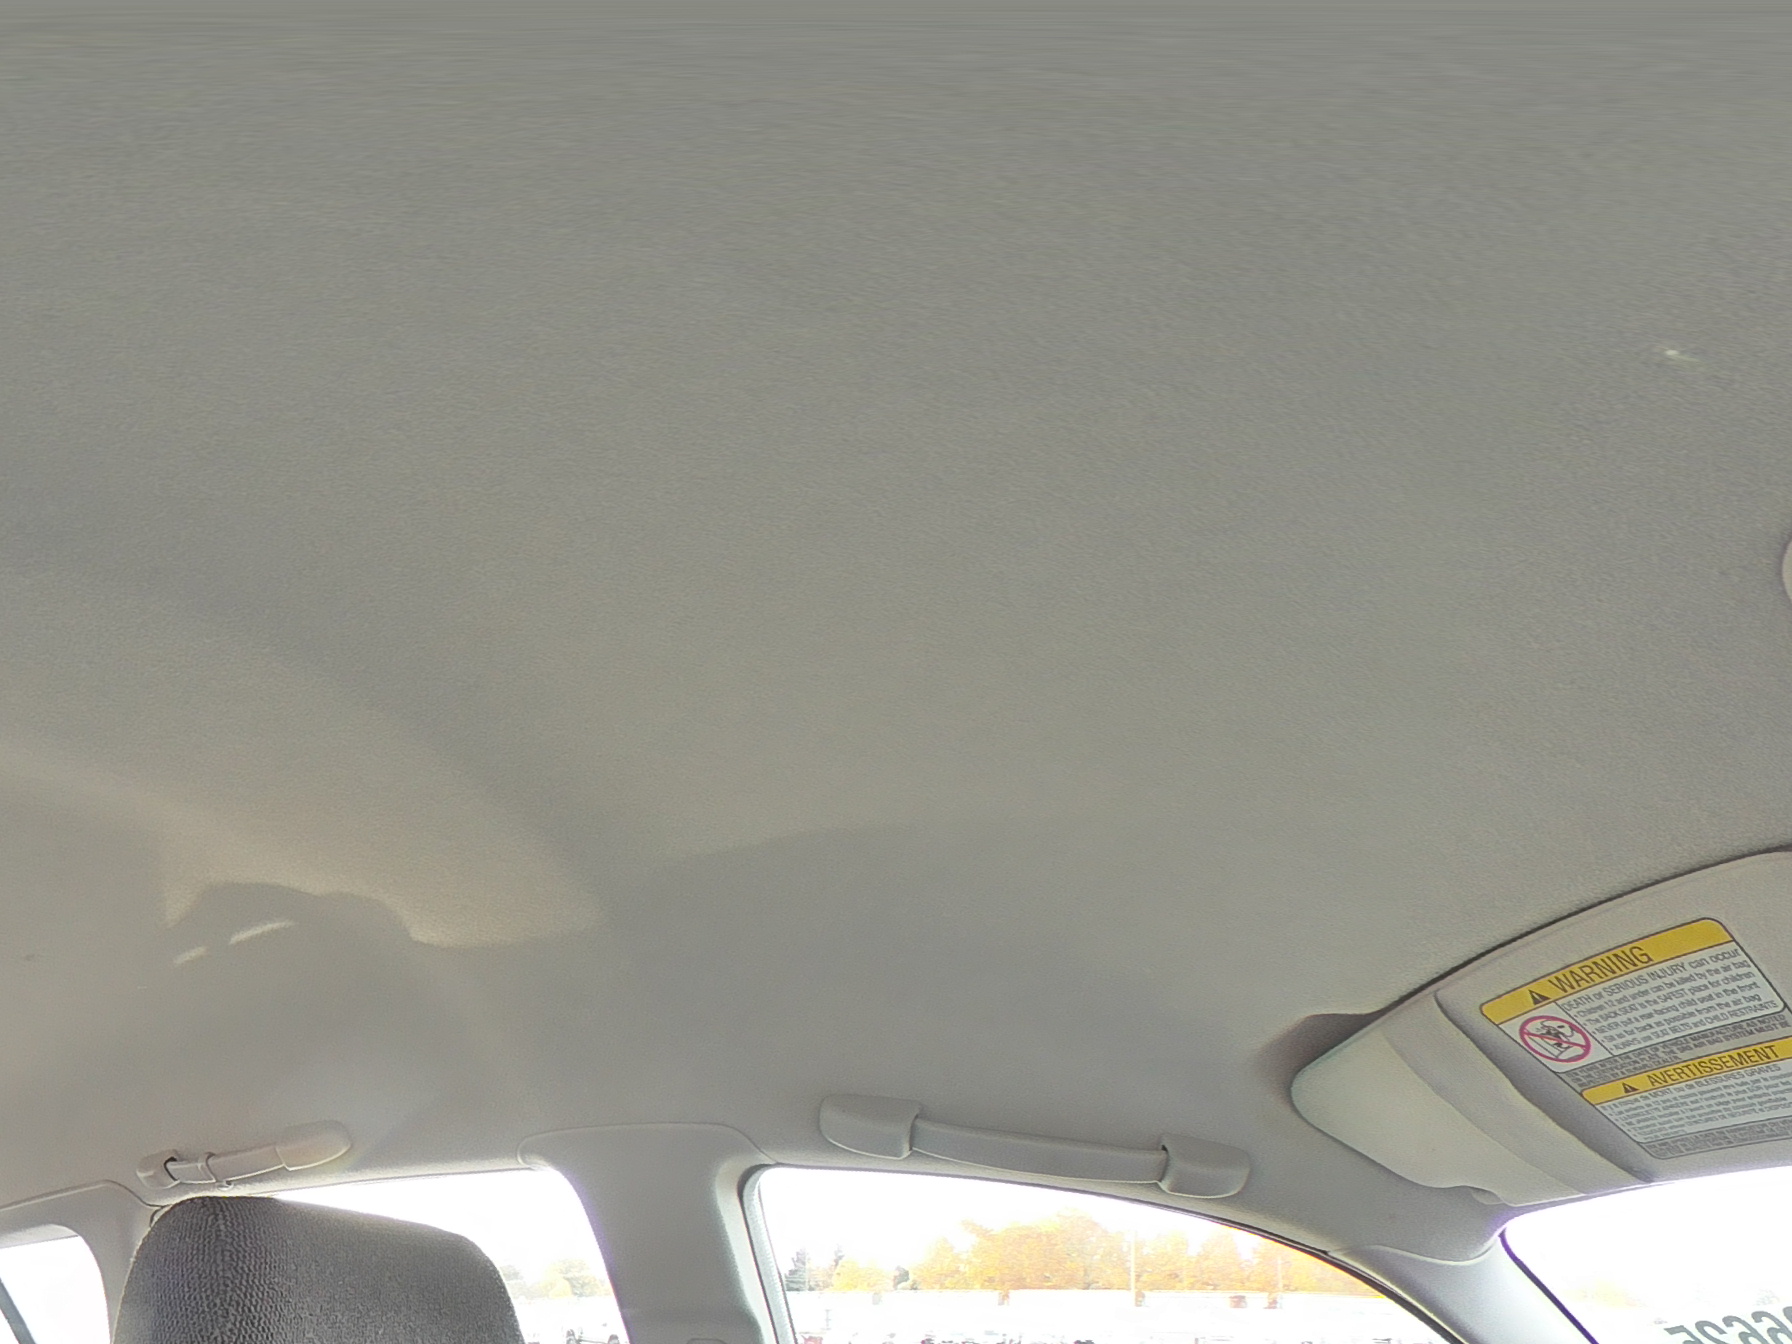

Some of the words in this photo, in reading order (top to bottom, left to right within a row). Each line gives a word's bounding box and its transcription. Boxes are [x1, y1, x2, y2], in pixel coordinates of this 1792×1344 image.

[1548, 946, 1652, 992] WARNING
[1561, 994, 1594, 1011] DEATH
[1592, 991, 1604, 1000] or
[1602, 974, 1648, 996] SERIOUS
[1646, 962, 1686, 980] INJURY
[1688, 957, 1709, 968] can
[1708, 948, 1740, 962] occur
[1603, 999, 1616, 1007] 12
[1614, 994, 1630, 1004] and
[1705, 968, 1721, 976] the
[1656, 988, 1687, 1002] SAFEST
[1707, 979, 1721, 987] for
[1678, 998, 1697, 1008] child
[1741, 993, 1761, 1002] bag
[1647, 1045, 1777, 1085] AVERTISSEMENT
[1744, 1063, 1780, 1076] GRAVES
